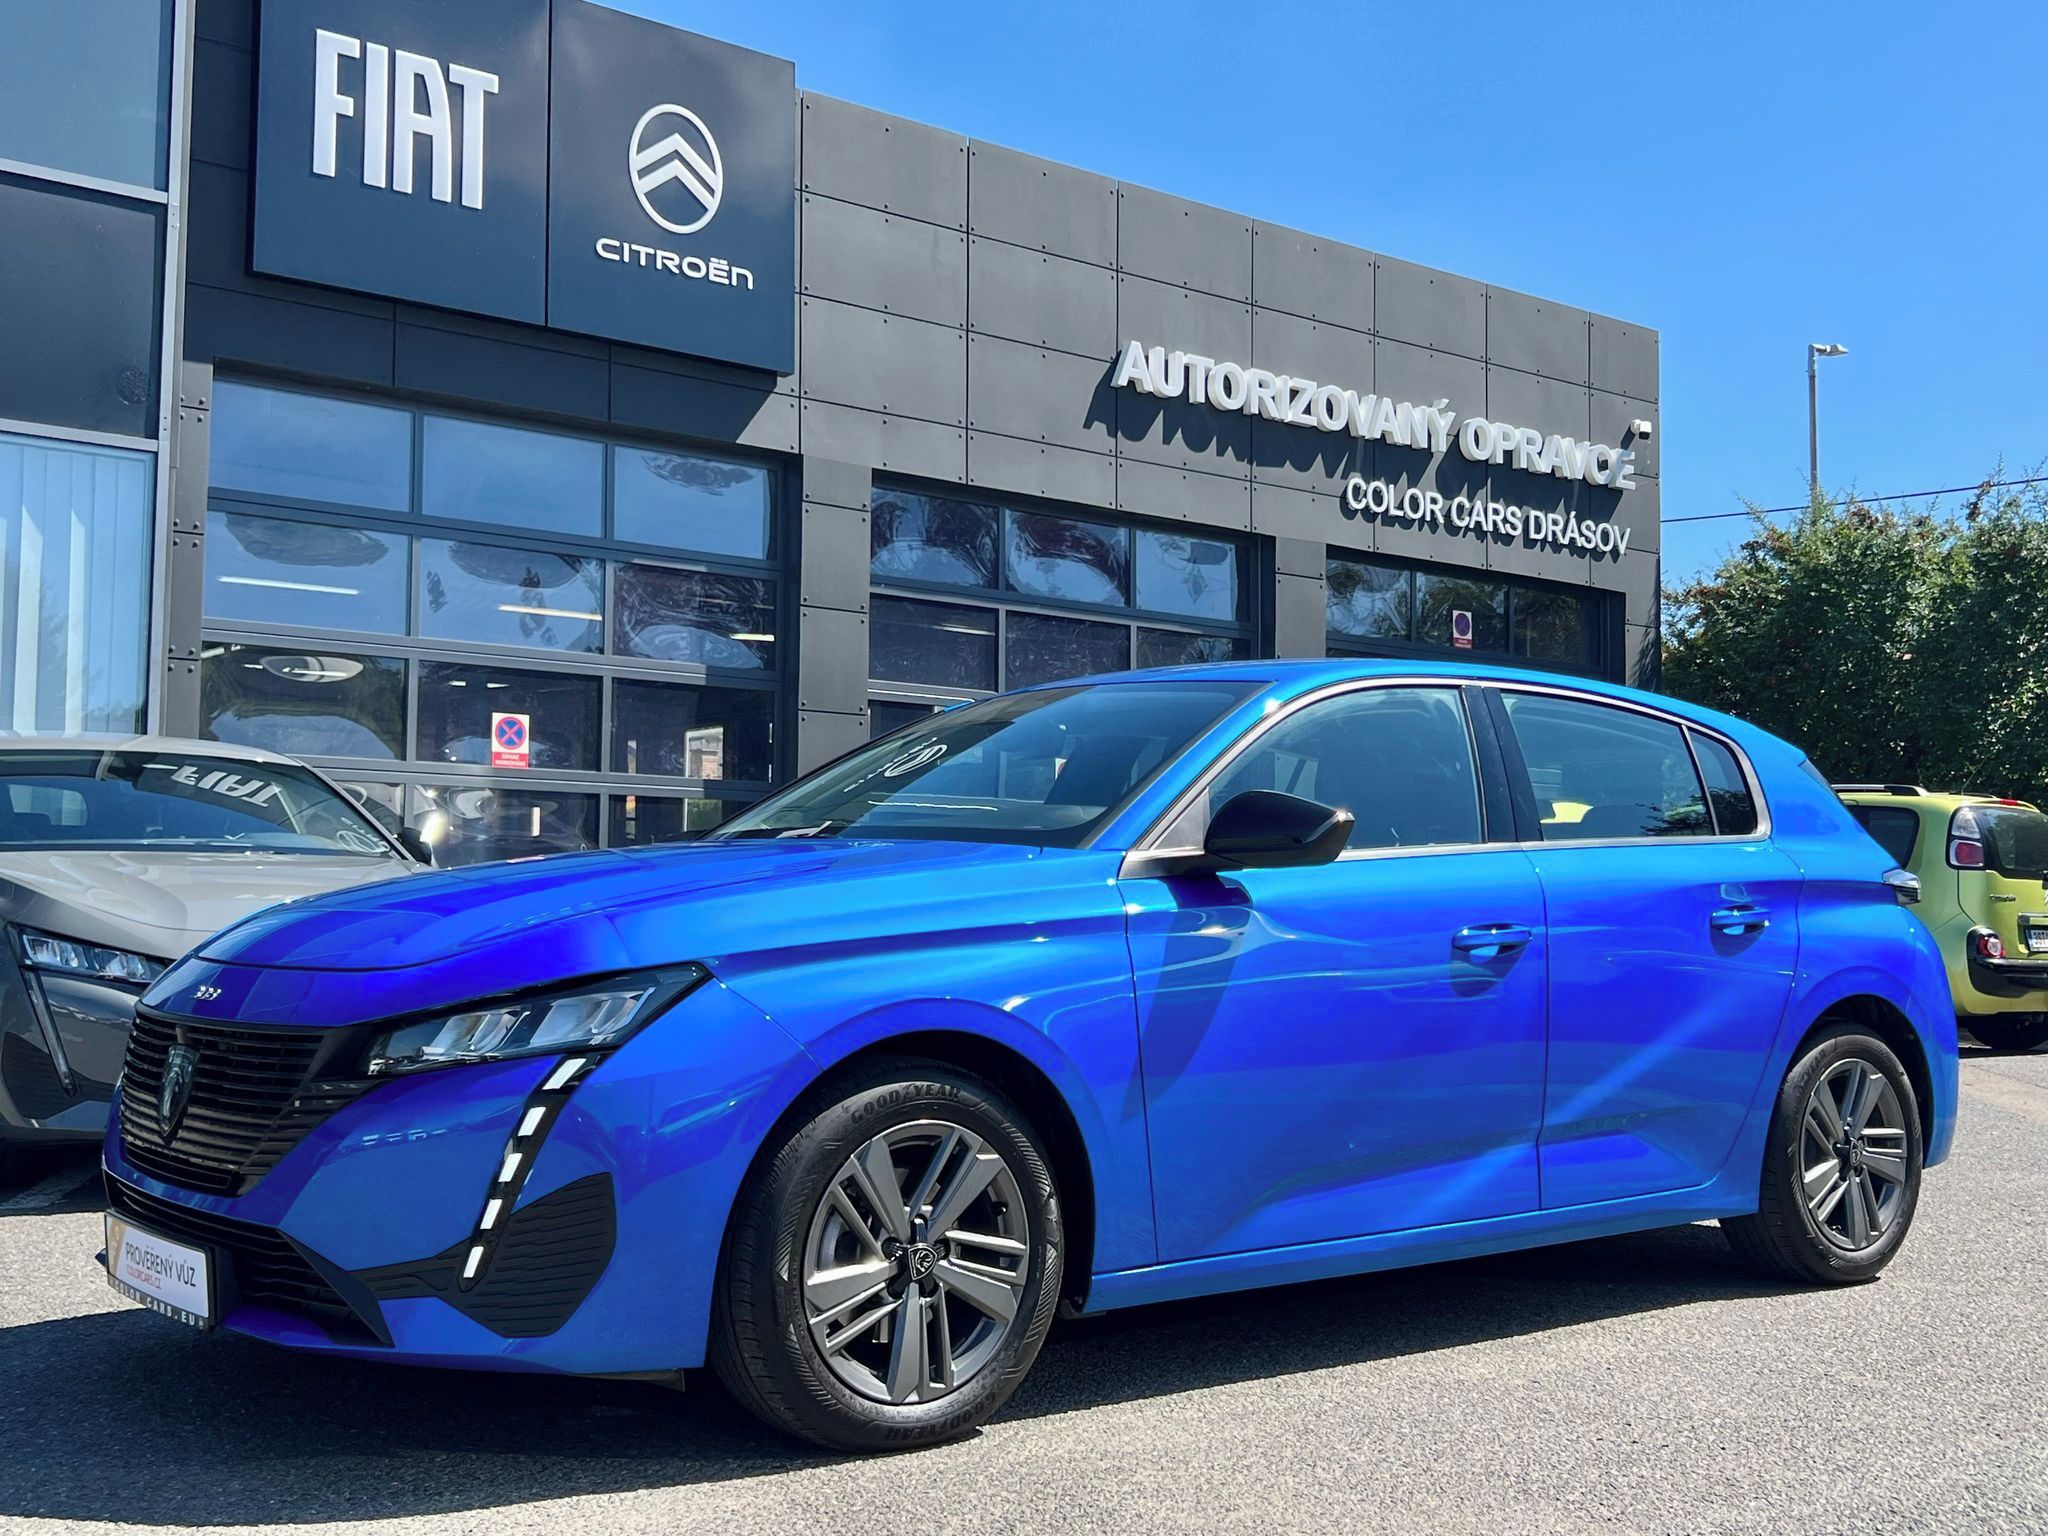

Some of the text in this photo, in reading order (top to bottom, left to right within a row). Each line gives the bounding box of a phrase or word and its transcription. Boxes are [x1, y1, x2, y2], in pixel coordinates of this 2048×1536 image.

[313, 28, 499, 210] FIAT
[595, 237, 754, 290] CITROËN
[1110, 340, 1636, 490] AUTORIZOVANÝ OPRAVCE
[1347, 477, 1631, 554] COLOR CARS DRÁSOV
[126, 1242, 196, 1287] PROVĚŘENÝ VŮZ
[146, 1300, 195, 1326] CARS.EU
